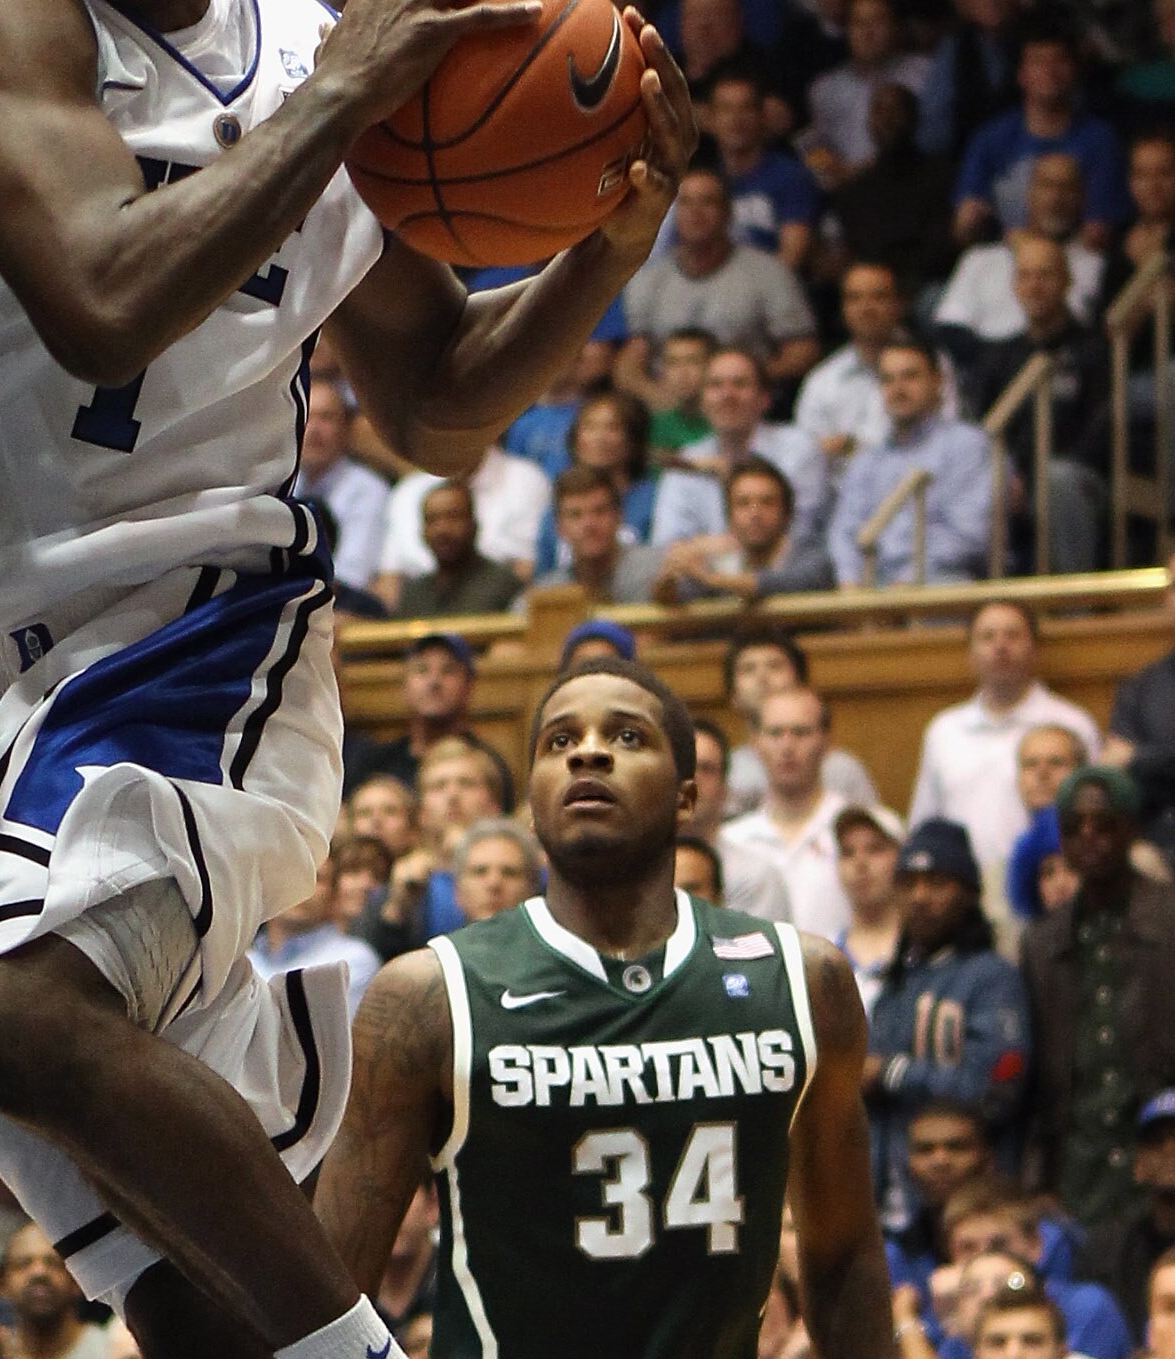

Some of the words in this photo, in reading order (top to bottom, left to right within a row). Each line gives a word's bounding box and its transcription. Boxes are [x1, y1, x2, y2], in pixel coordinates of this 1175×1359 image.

[914, 990, 963, 1065] 10
[488, 1029, 796, 1107] SPARTANS
[572, 1121, 746, 1260] 34
